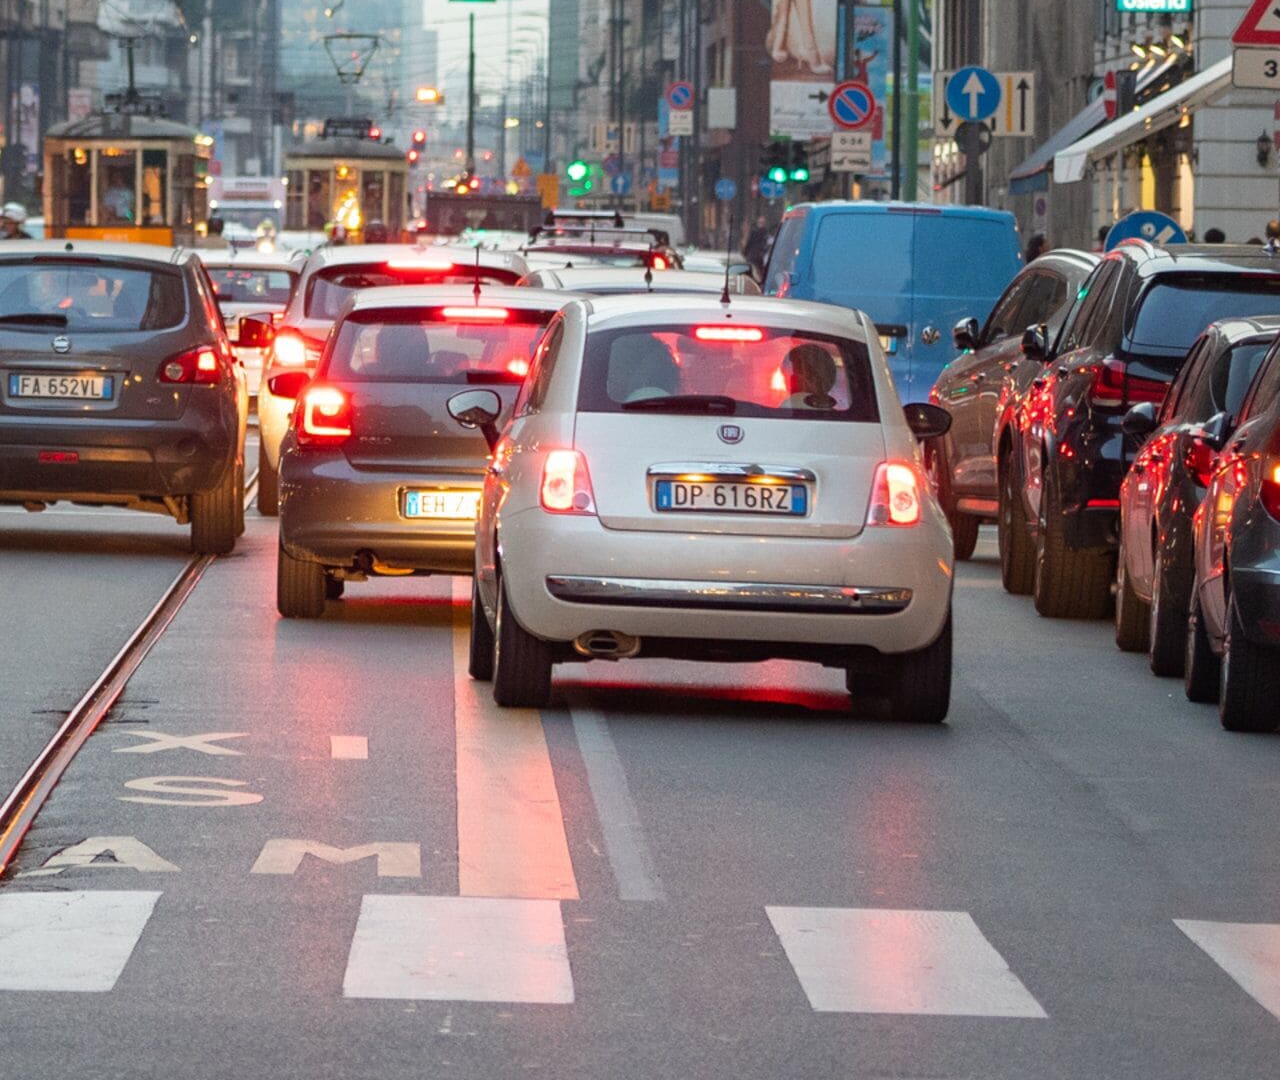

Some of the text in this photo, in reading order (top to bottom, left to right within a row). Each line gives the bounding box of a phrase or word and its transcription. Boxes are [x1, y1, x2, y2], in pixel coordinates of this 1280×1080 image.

[21, 378, 100, 397] FA 652VL
[674, 484, 789, 510] DP 616RZ
